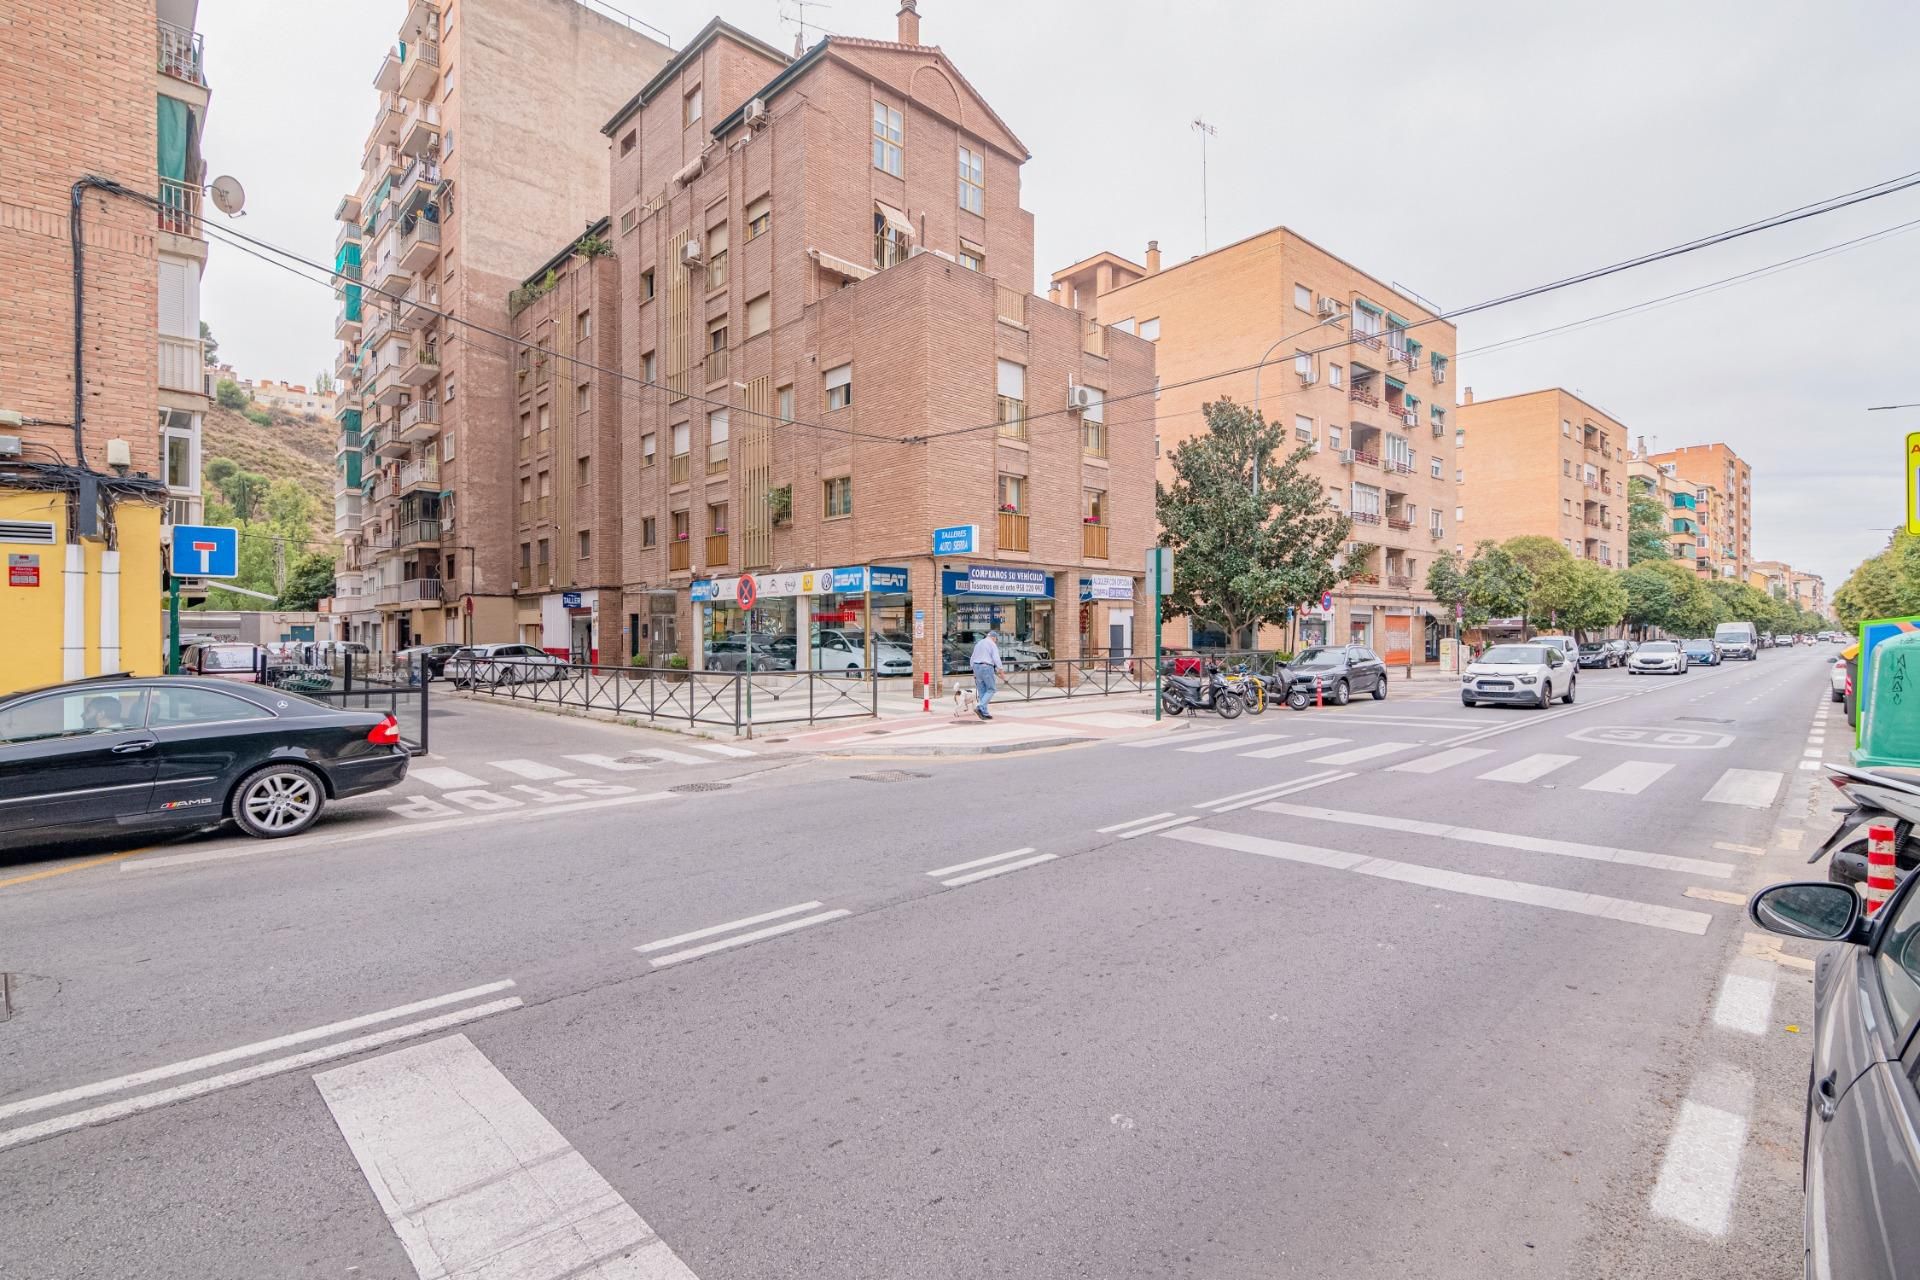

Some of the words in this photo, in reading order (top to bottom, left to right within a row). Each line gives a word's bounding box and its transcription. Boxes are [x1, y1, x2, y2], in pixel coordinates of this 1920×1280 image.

[942, 530, 967, 539] TALLERES
[939, 541, 952, 551] AUTO
[834, 574, 862, 587] SEAT
[872, 573, 906, 587] SEAT
[971, 568, 1007, 580] COMPRAMOS
[1008, 571, 1016, 580] SU
[1017, 570, 1043, 581] VEHÍCULO
[971, 581, 992, 590] Tasamos
[1005, 583, 1015, 591] acto
[1016, 584, 1025, 592] 958
[177, 797, 212, 807] AMG
[386, 778, 637, 819] STOP
